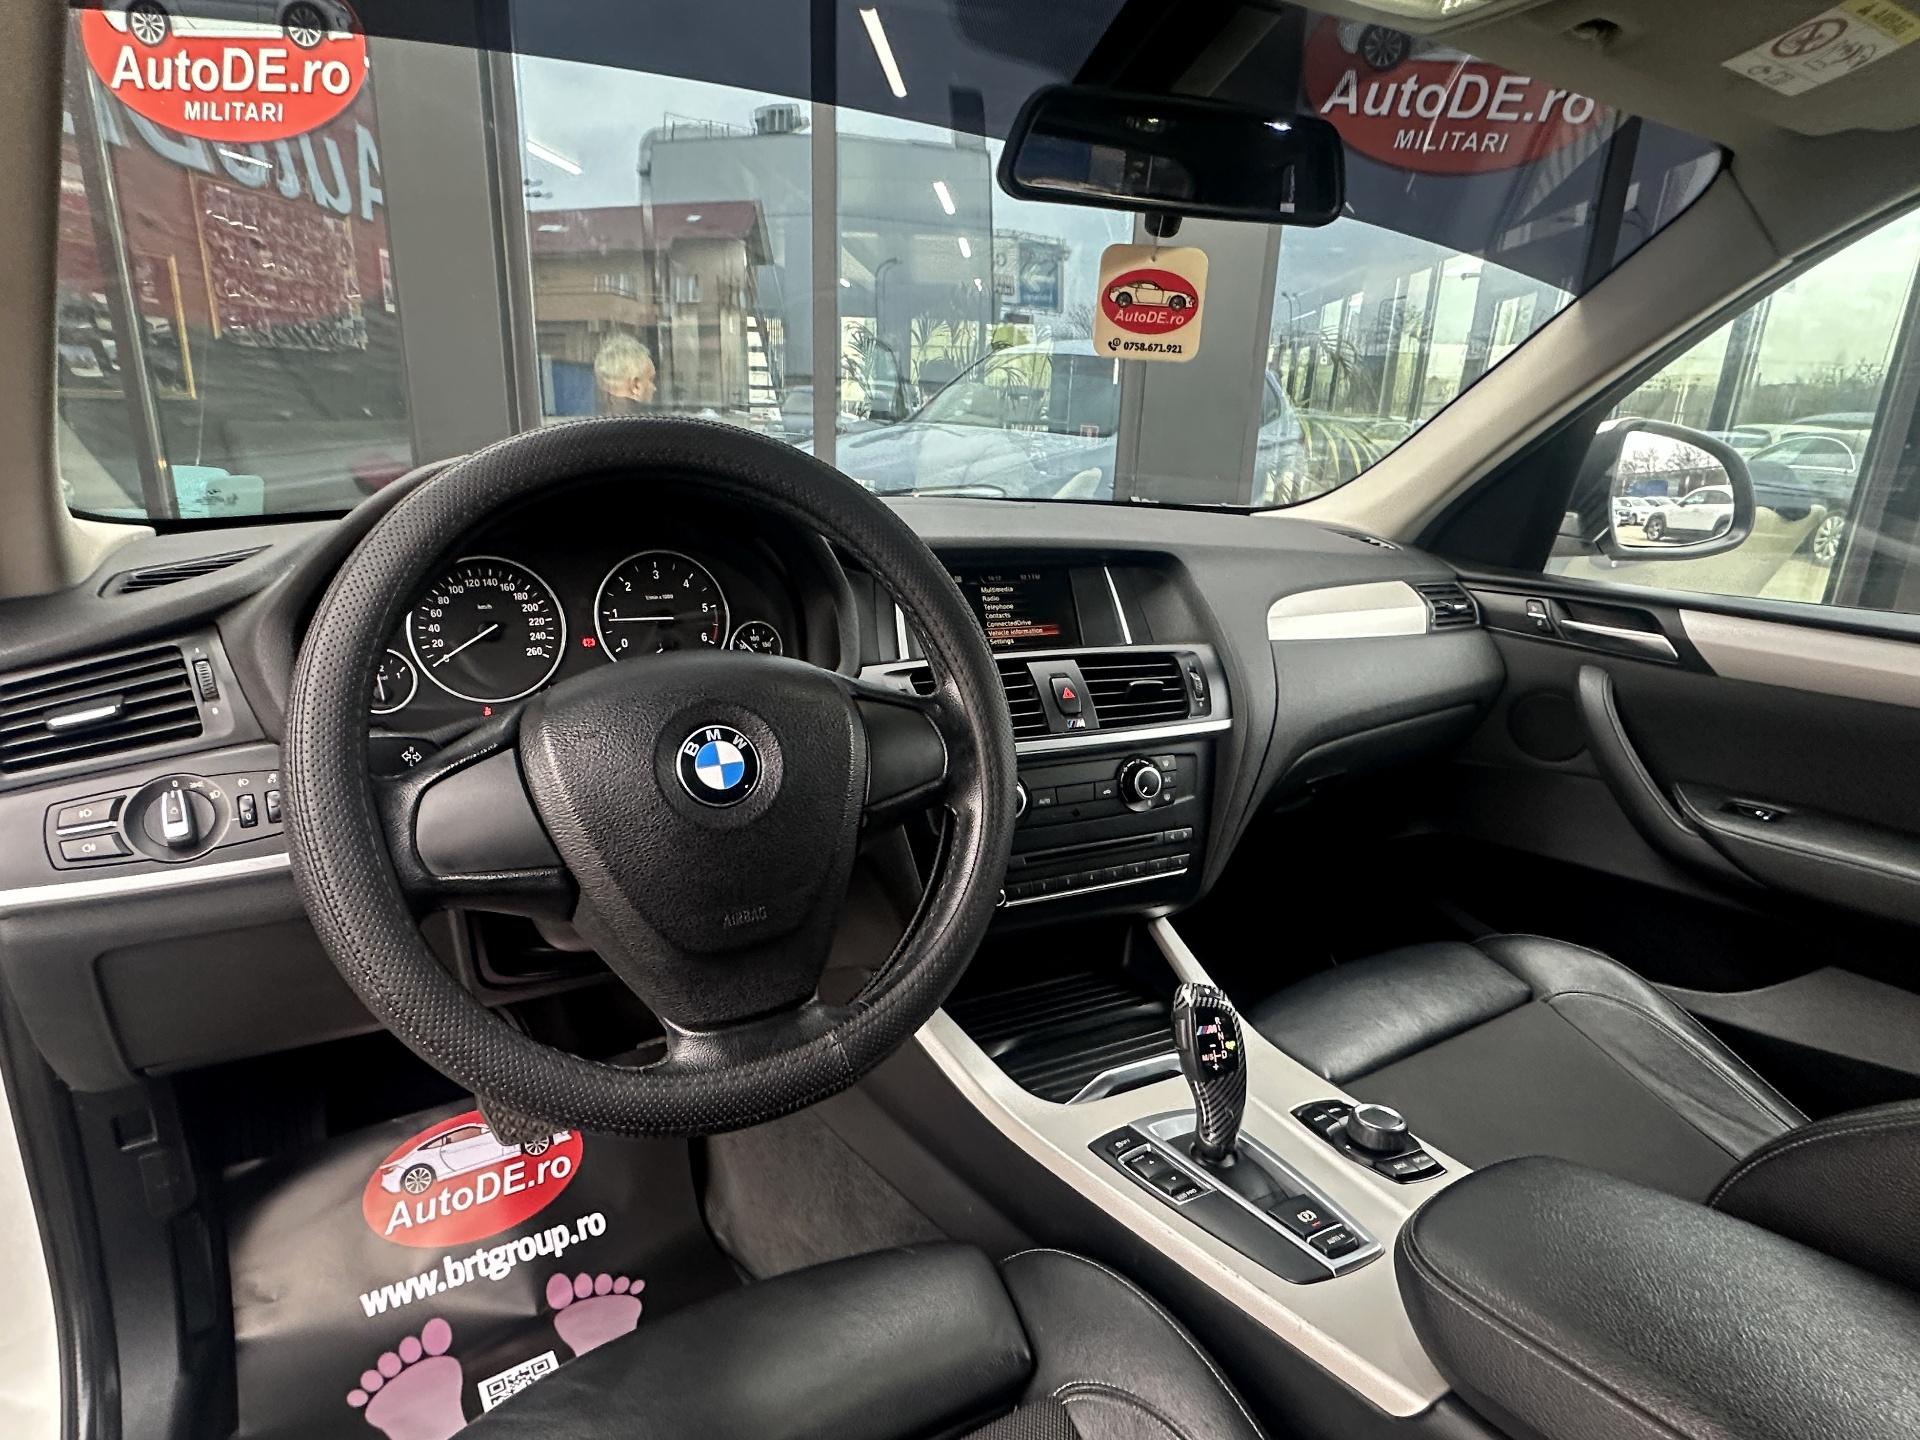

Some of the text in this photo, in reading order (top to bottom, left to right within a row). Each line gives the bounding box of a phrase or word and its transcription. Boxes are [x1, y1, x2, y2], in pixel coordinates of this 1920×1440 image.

[111, 44, 351, 95] AutoDE.ro
[1319, 70, 1595, 124] AutoDE.ro
[183, 102, 284, 123] MILITARI
[1393, 129, 1509, 153] MILITARI
[1113, 309, 1185, 326] AutoDE.ro
[1123, 341, 1183, 354] 0758.671.921
[652, 569, 660, 580] 3
[464, 578, 481, 588] 120
[482, 577, 498, 588] 140
[500, 582, 516, 592] 160
[624, 581, 632, 592] 2
[683, 578, 690, 589] 4
[448, 585, 464, 594] 100
[980, 586, 1014, 594] Multimedia
[437, 595, 450, 605] 80
[512, 591, 528, 601] 180
[521, 603, 539, 613] 200
[701, 602, 708, 613] 5
[983, 603, 1014, 611] Telephone
[430, 608, 443, 618] 60
[612, 608, 618, 618] 1
[528, 617, 545, 626] 220
[986, 619, 1032, 628] ConnectedDrive
[428, 623, 441, 633] 40
[988, 629, 1010, 637] Vehicle
[529, 631, 546, 641] 240
[701, 632, 708, 642] 6
[431, 638, 444, 648] 20
[621, 638, 629, 649] 0
[989, 637, 1015, 646] Settings
[526, 647, 543, 657] 260
[684, 728, 748, 757] BMW
[722, 906, 768, 928] AIRBAG
[1221, 1050, 1228, 1060] D
[385, 1155, 572, 1236] AutoDE.ro
[359, 1212, 607, 1318] www.brtgroup.ro
